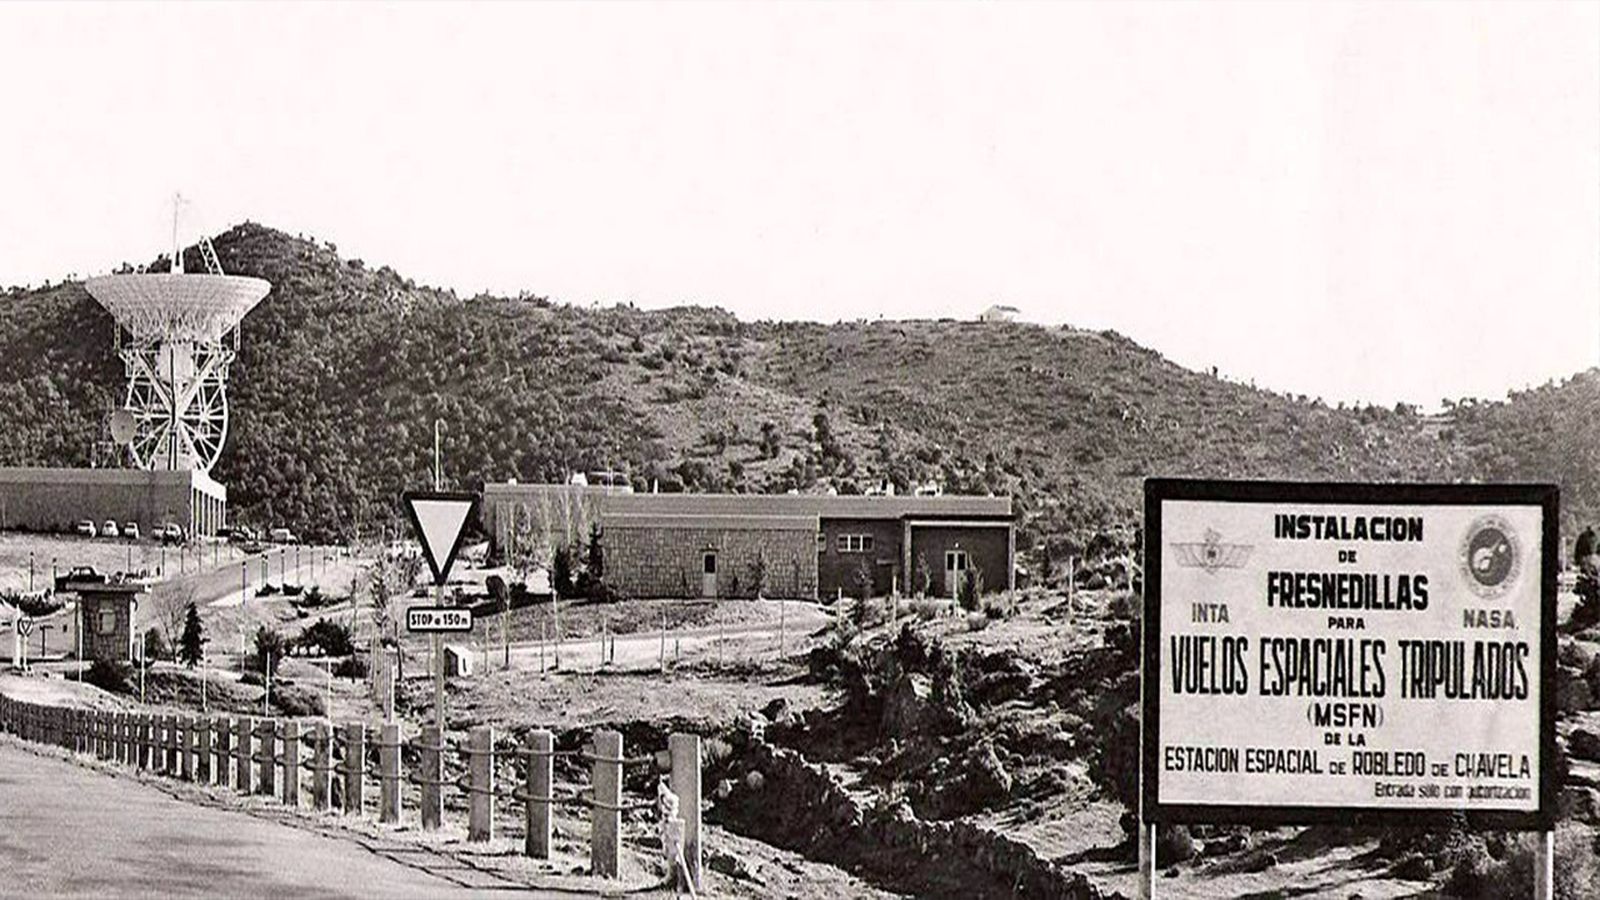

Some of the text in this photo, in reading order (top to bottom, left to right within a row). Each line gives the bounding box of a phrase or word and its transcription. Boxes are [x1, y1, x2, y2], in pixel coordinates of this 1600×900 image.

[1274, 514, 1424, 542] INSTALACION
[1338, 550, 1357, 564] DE
[1267, 572, 1429, 611] FRESNEDILLAS
[411, 613, 433, 625] STOP
[1191, 602, 1230, 624] INTA
[1327, 616, 1366, 631] PARA
[1170, 635, 1530, 701] VUELOS ESPACIALES TRIPULADOS
[1306, 703, 1385, 728] (MSFN)
[1324, 733, 1366, 747] DE LA
[1164, 746, 1531, 779] ESTACION ESPACIAL DE ROBLEDO DE CHAVELA
